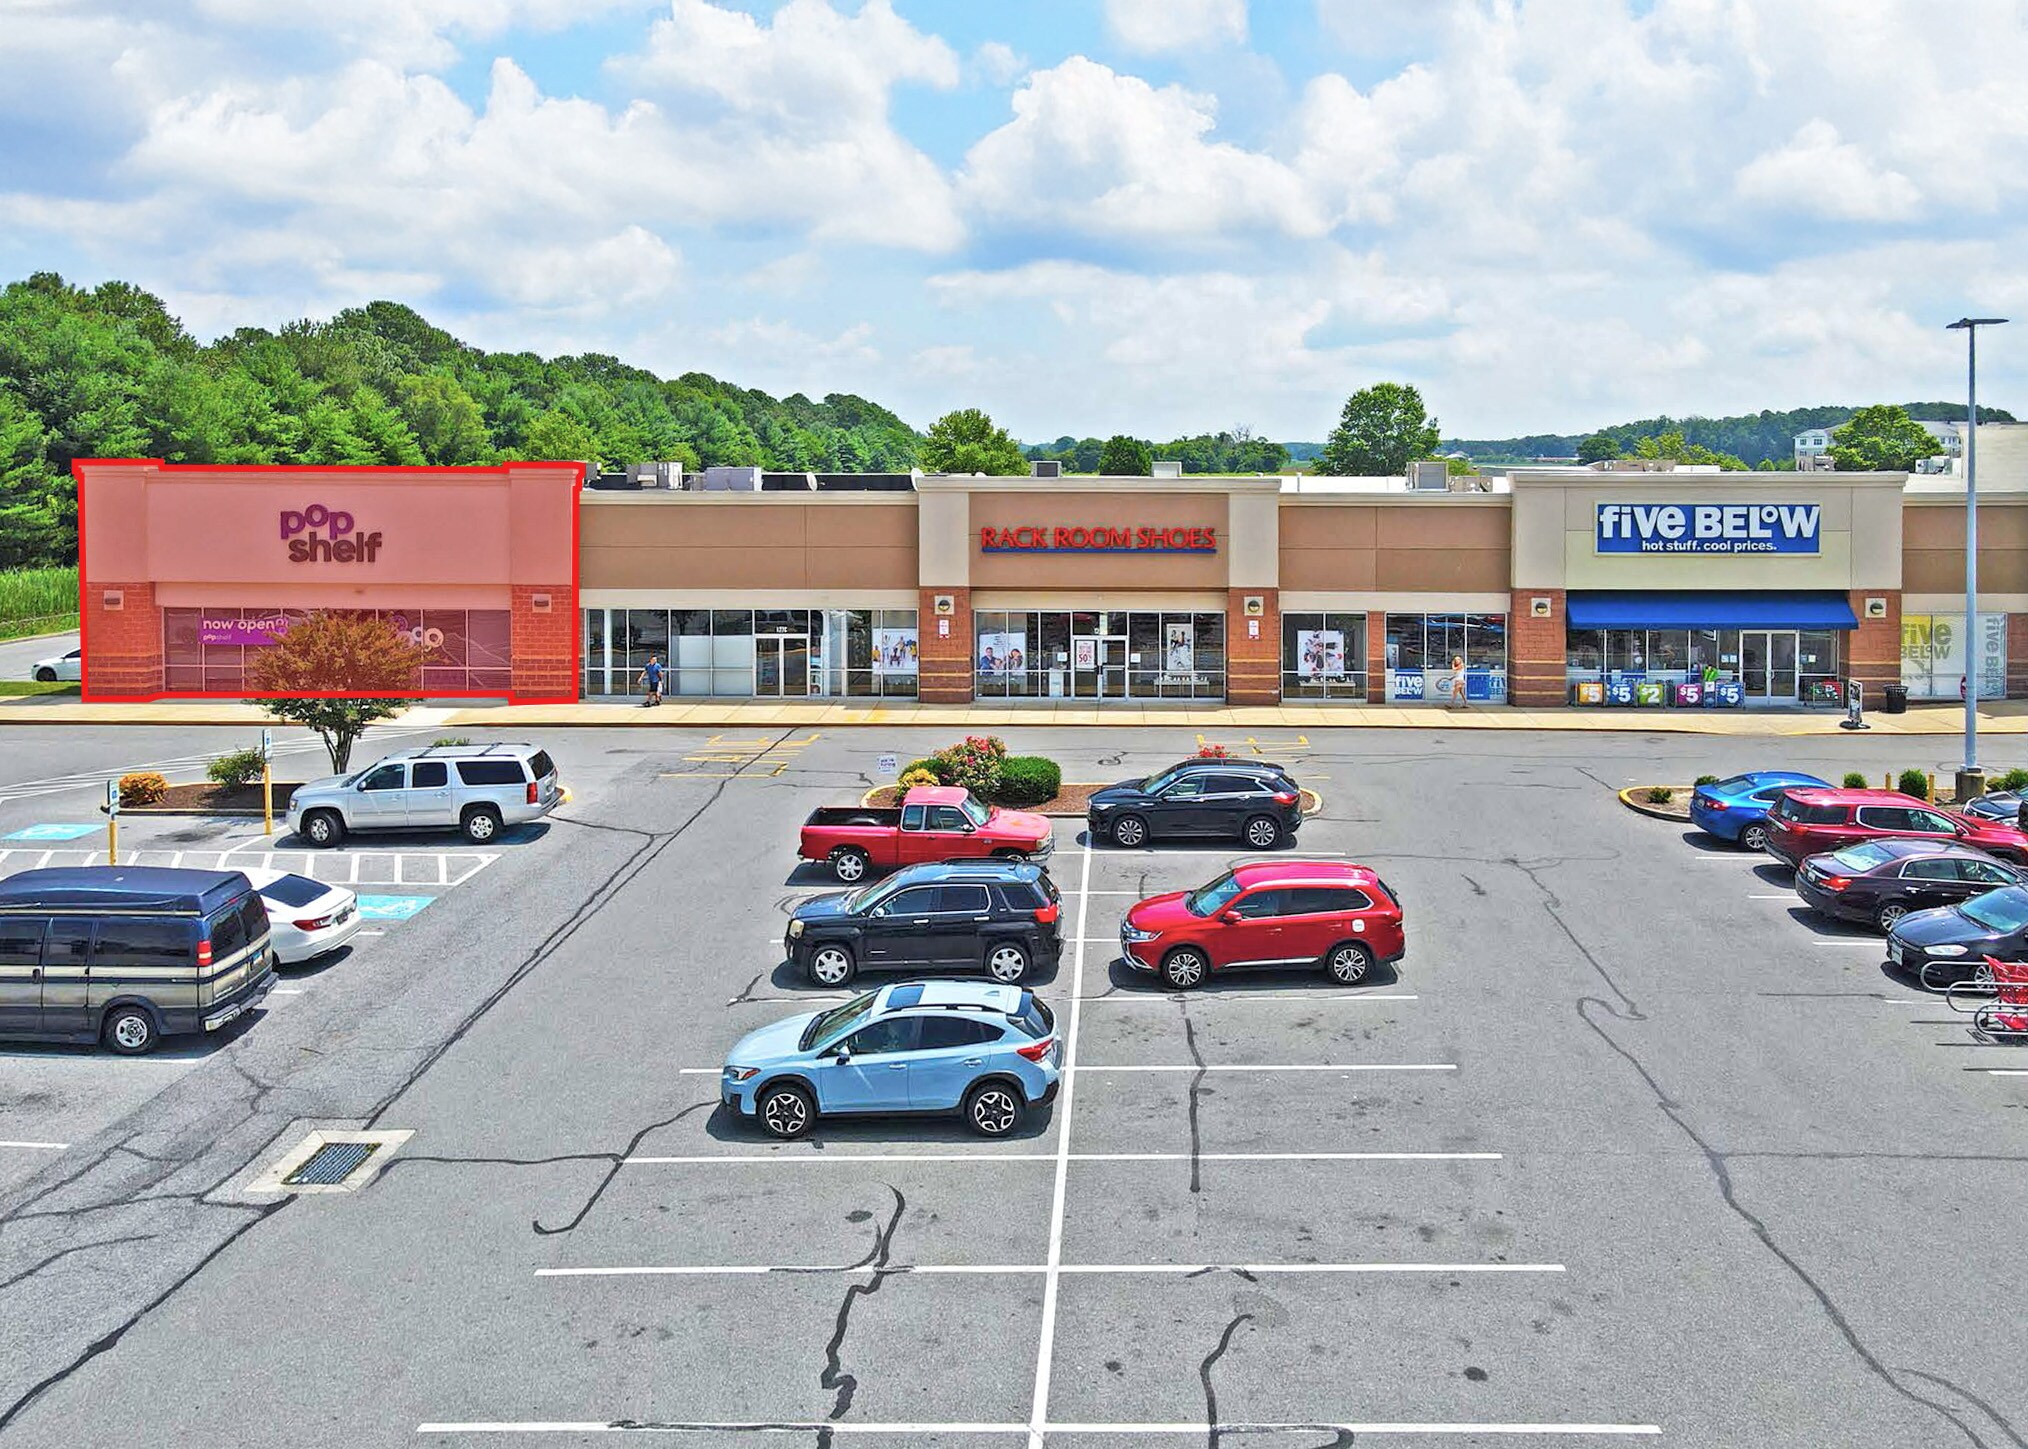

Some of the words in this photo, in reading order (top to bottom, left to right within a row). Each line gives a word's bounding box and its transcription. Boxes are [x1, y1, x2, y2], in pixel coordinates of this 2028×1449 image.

[281, 504, 354, 540] pop
[1600, 506, 1686, 538] five
[1695, 506, 1820, 538] BELOW
[981, 527, 1048, 548] RACK
[1054, 527, 1131, 548] ROOM
[1137, 527, 1216, 549] SHOES
[1642, 540, 1663, 550] hot
[1665, 540, 1700, 550] stuff.
[1703, 540, 1731, 550] cool
[1734, 540, 1777, 553] prices.
[288, 532, 382, 562] shelf
[203, 620, 234, 629] now
[238, 620, 275, 633] open
[1395, 675, 1424, 687] five
[1582, 686, 1600, 703] $5
[1612, 686, 1631, 703] $5
[1641, 687, 1660, 704] $2
[1680, 686, 1699, 703] $5
[1720, 686, 1739, 703] $5
